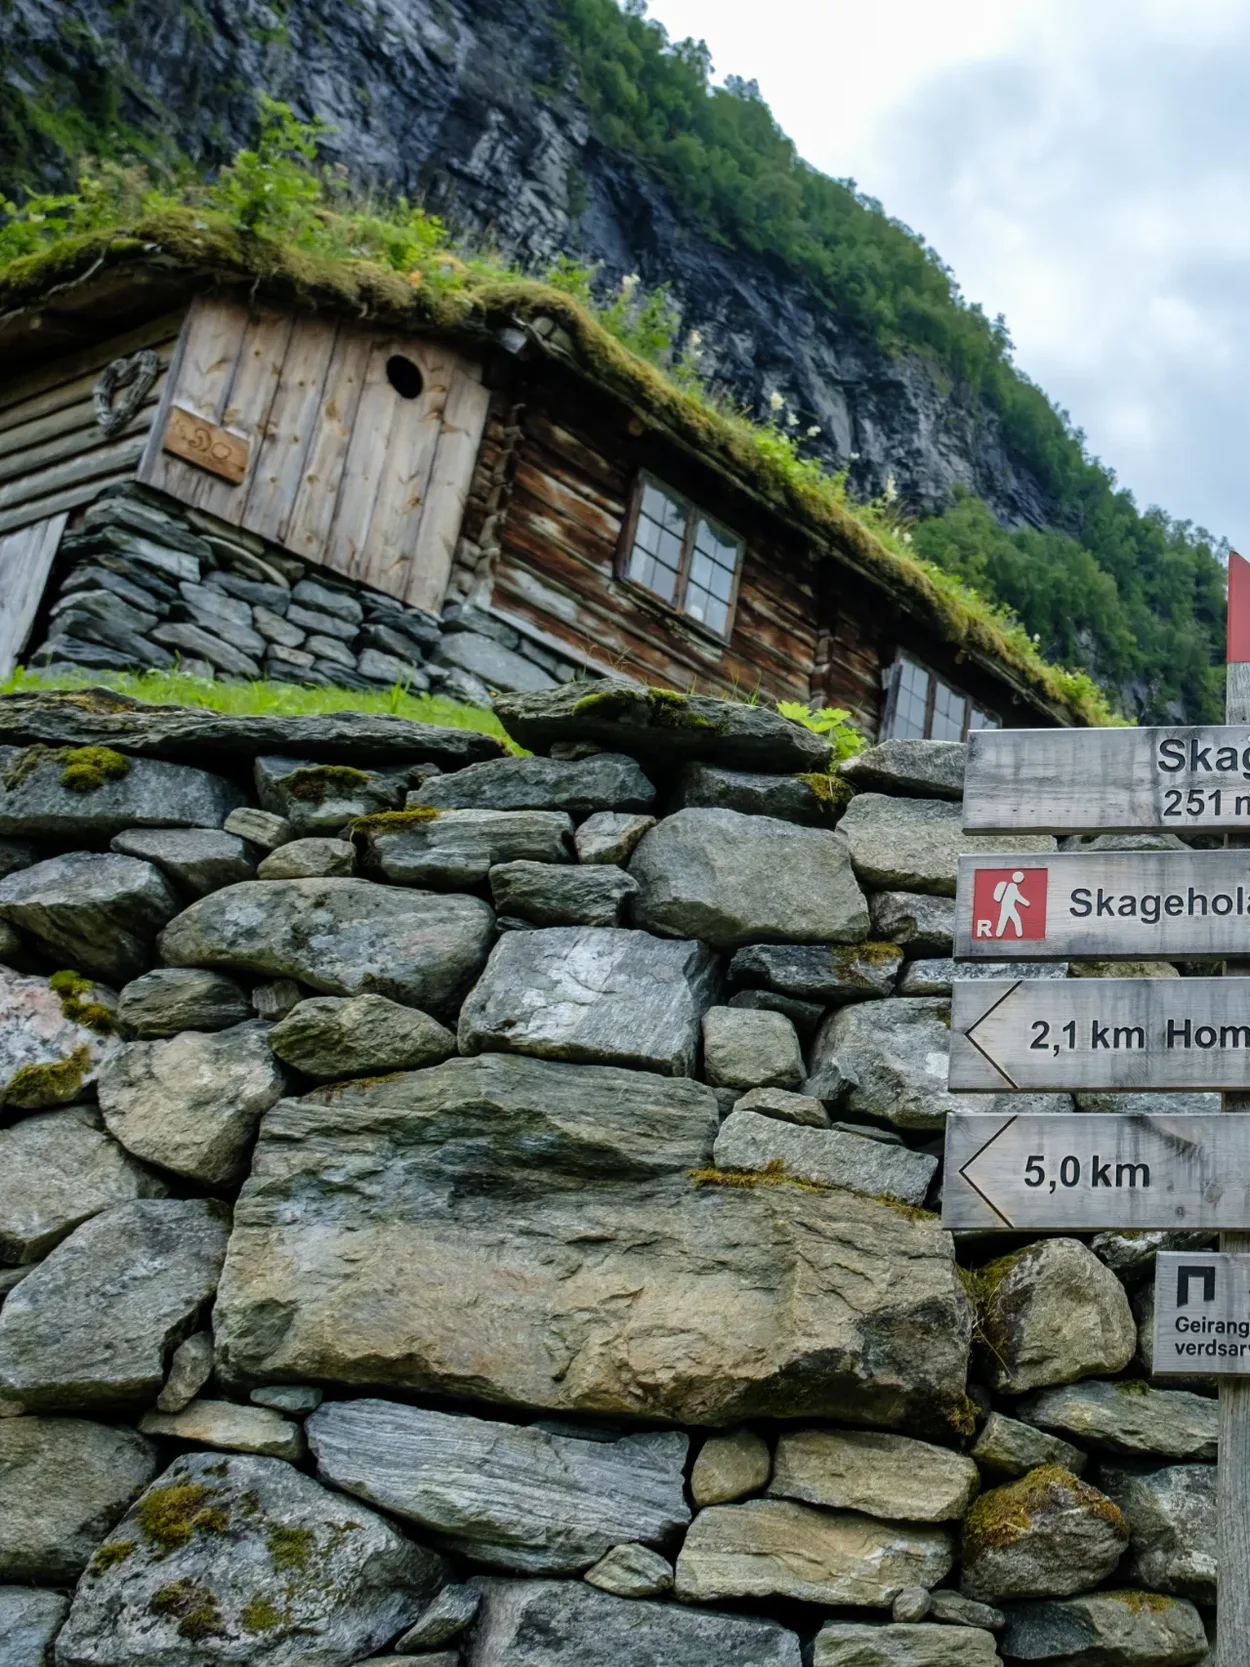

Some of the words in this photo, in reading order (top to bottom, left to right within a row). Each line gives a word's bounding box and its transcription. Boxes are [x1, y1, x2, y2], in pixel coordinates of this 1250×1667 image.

[1163, 789, 1222, 817] 251
[977, 919, 992, 937] R
[1030, 1020, 1077, 1057] 2,1
[1091, 1020, 1145, 1050] km
[1024, 1155, 1081, 1194] 5,0
[1091, 1155, 1150, 1187] km
